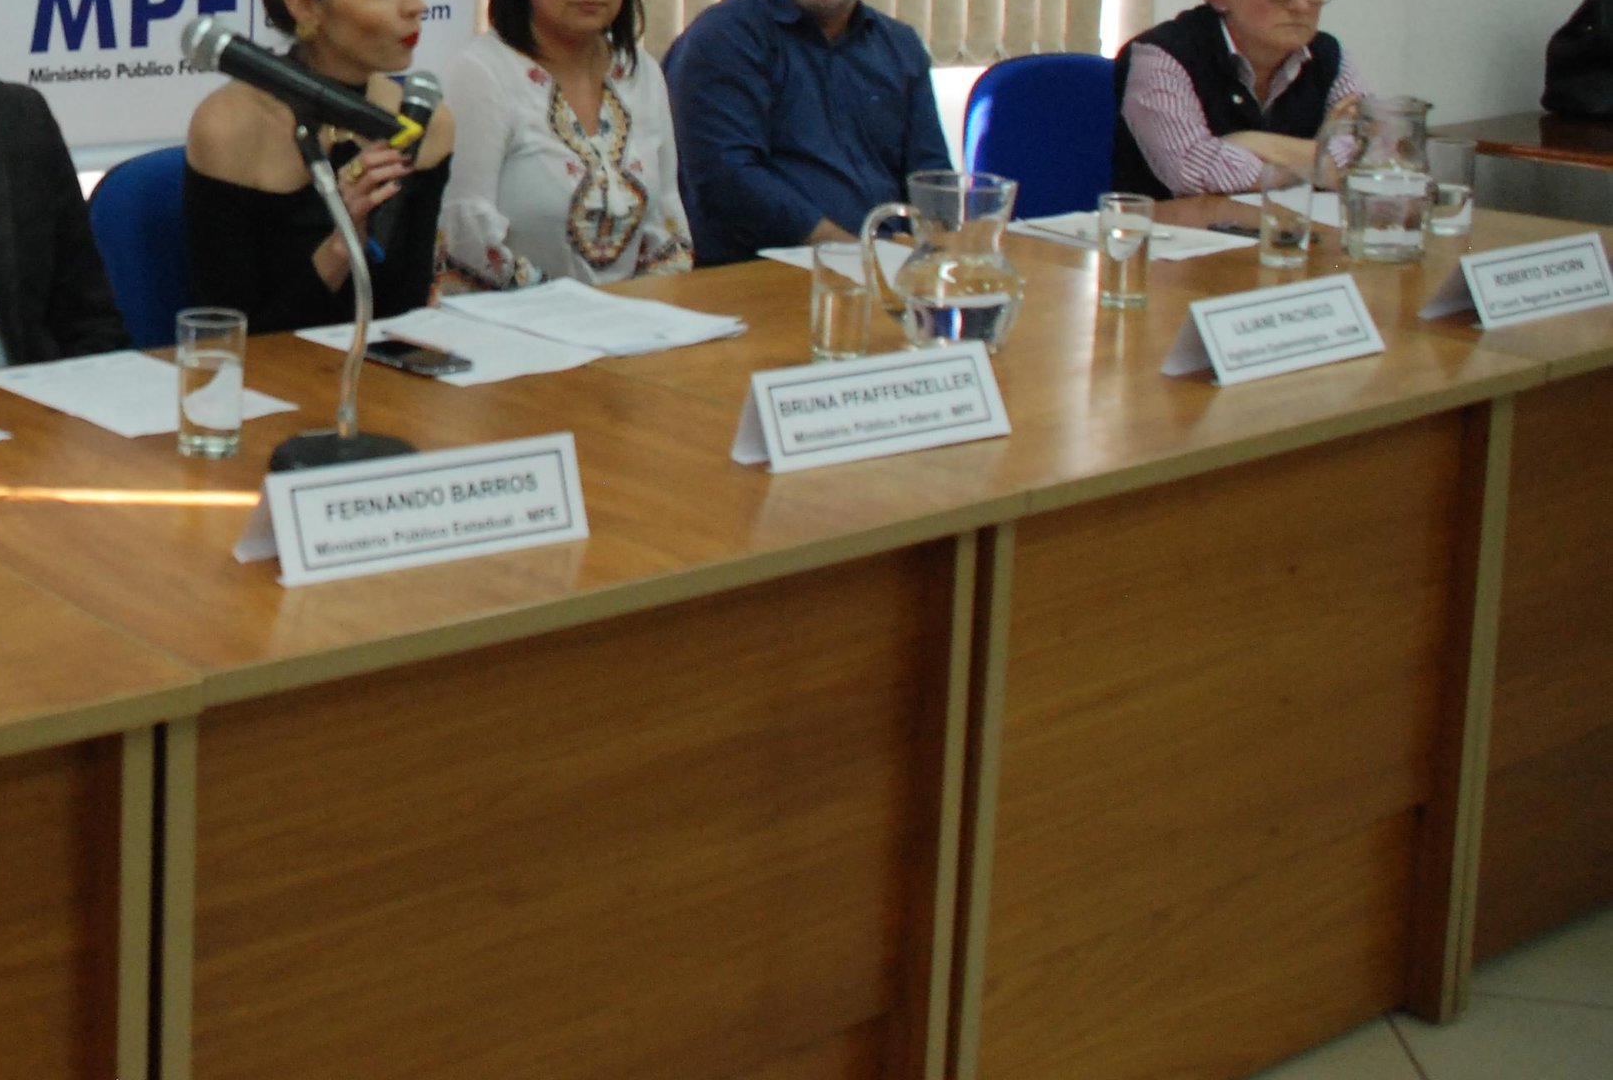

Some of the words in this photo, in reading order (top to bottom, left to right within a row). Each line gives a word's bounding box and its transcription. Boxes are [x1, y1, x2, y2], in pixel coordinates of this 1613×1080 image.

[29, 65, 111, 84] Ministério
[116, 60, 174, 79] Público
[779, 395, 838, 417] BRUNA
[843, 373, 974, 407] PFAFFENZELLER
[325, 488, 445, 521] FERNANDO
[452, 473, 538, 502] BARROS
